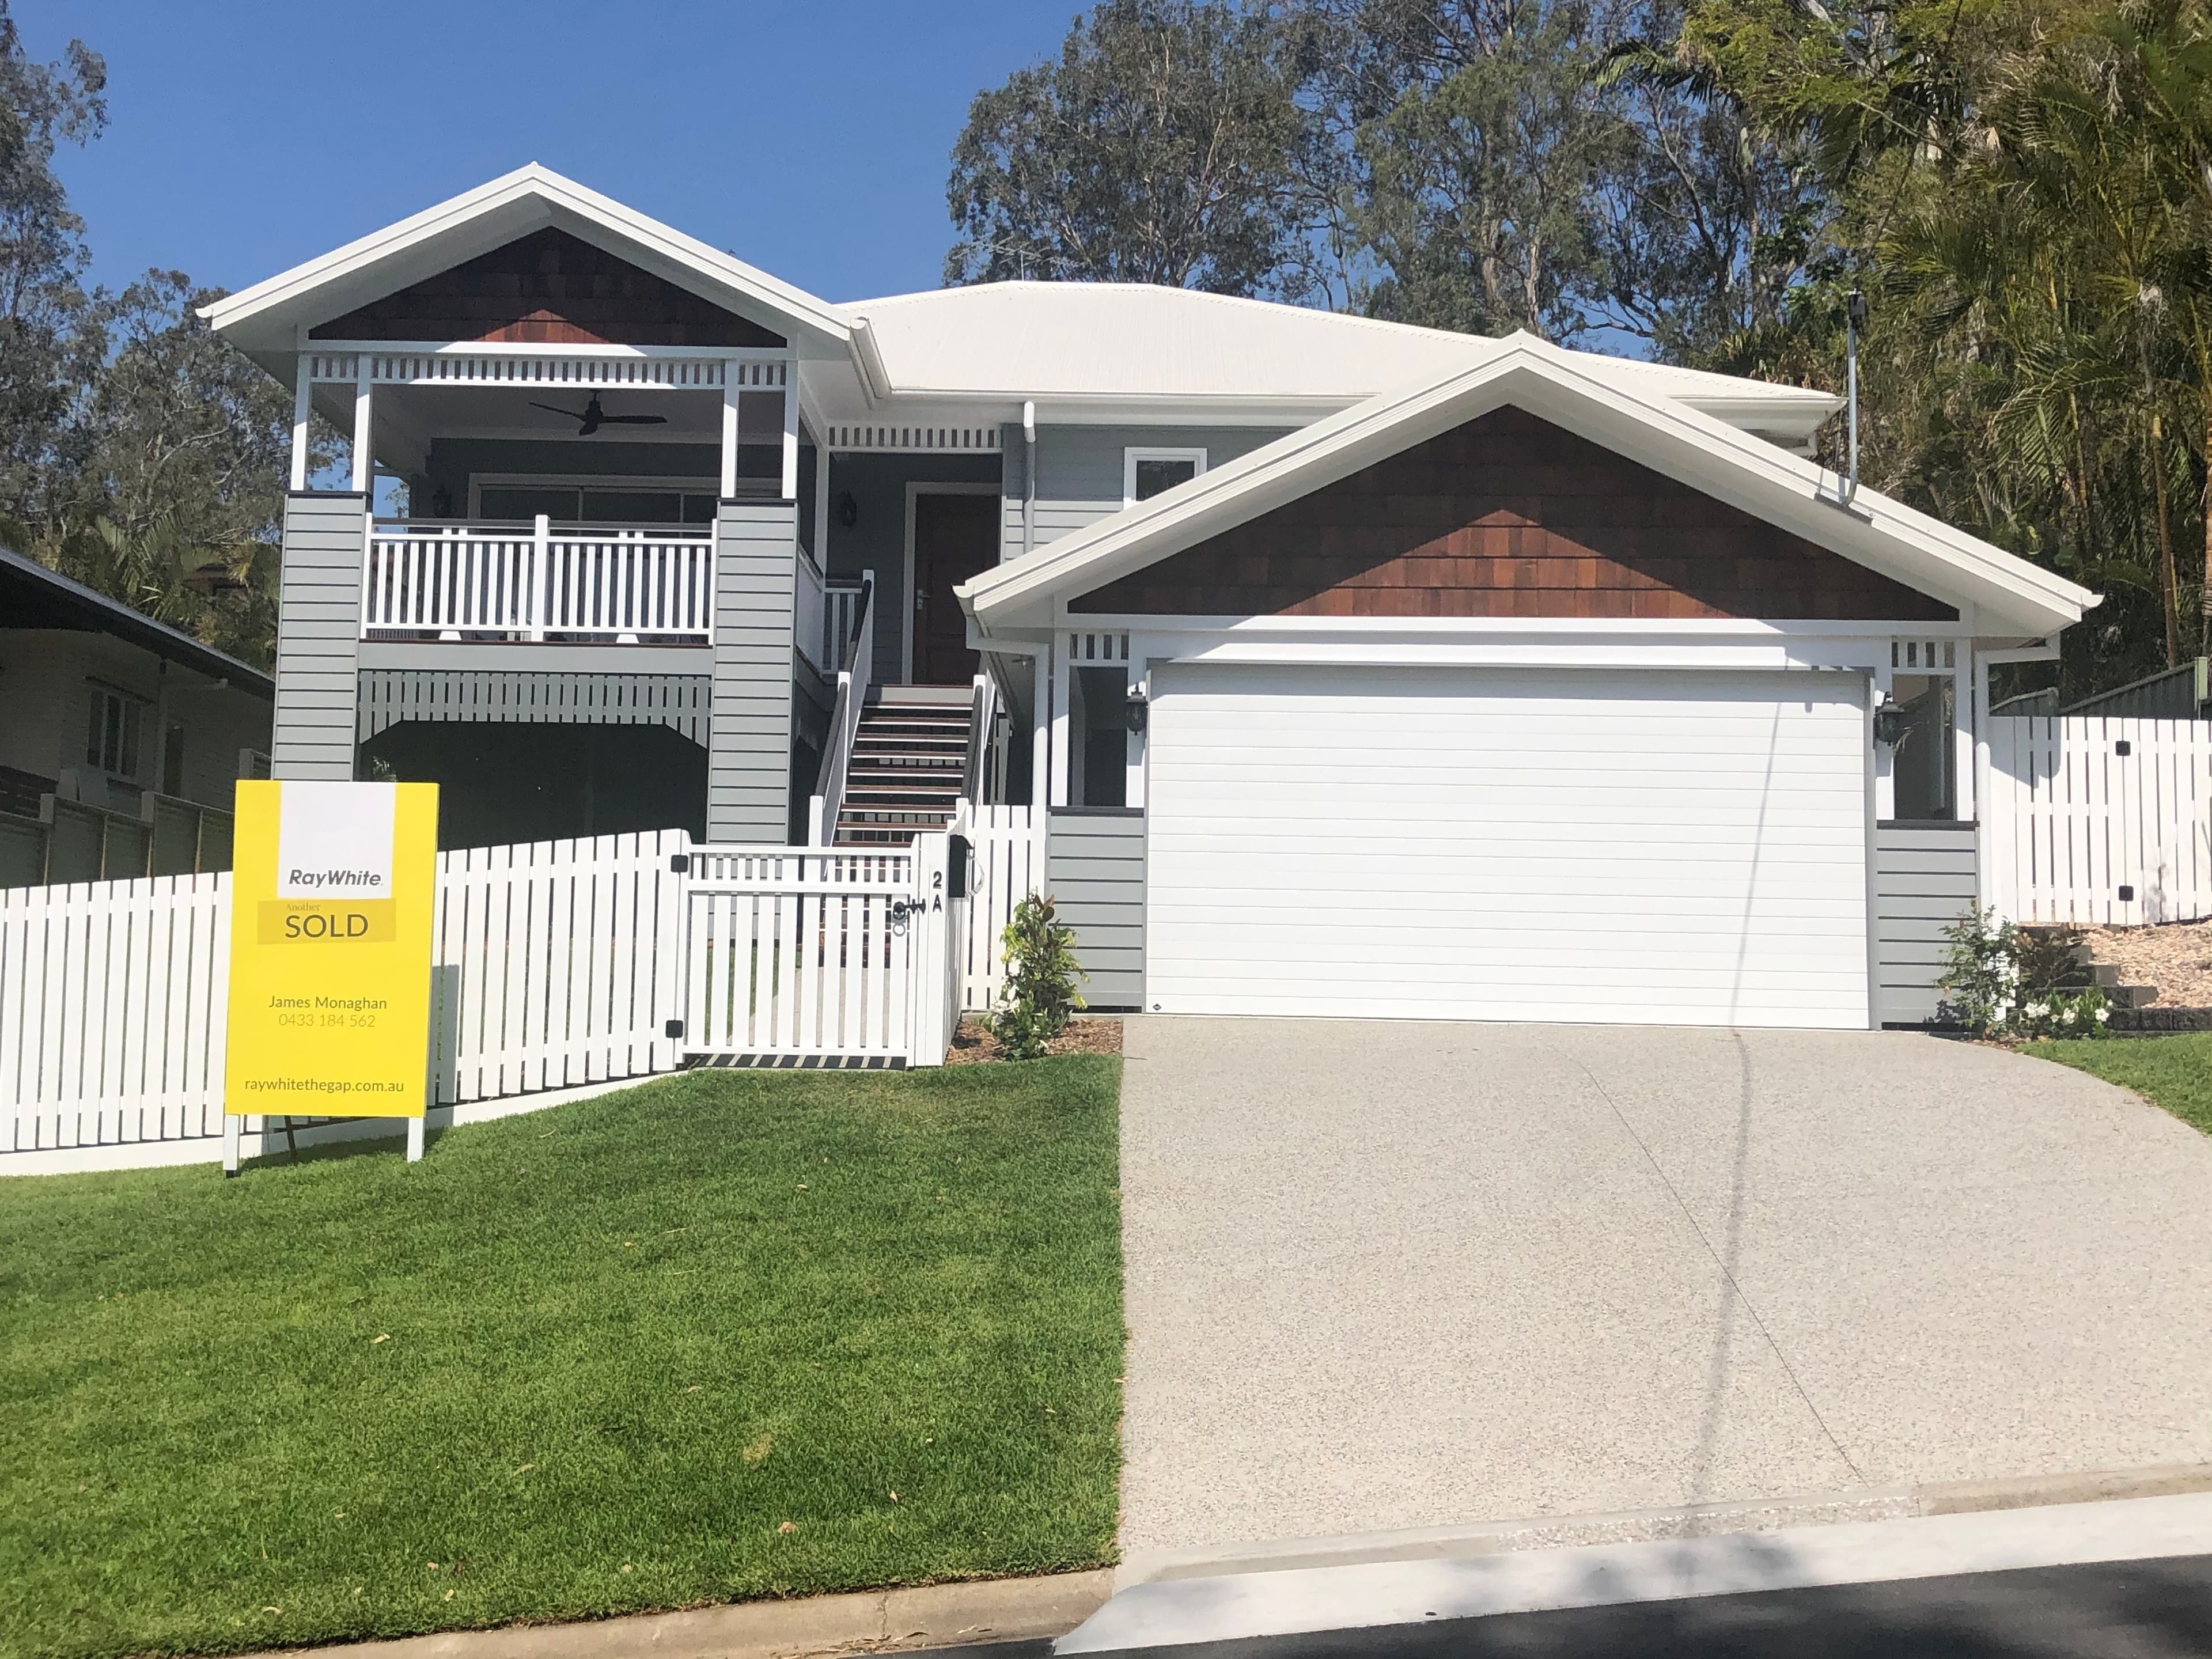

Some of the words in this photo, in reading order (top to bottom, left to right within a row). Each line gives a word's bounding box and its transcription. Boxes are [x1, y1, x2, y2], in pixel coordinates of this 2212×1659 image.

[933, 871, 942, 888] 2
[286, 903, 321, 911] Another
[933, 894, 942, 912] A
[285, 914, 369, 938] SOLD
[268, 995, 310, 1009] James
[315, 996, 387, 1012] Monaghan
[279, 1014, 314, 1027] 0433
[320, 1014, 345, 1027] 184
[350, 1014, 376, 1027] 562
[245, 1078, 404, 1094] raywhitethegap.com.au
